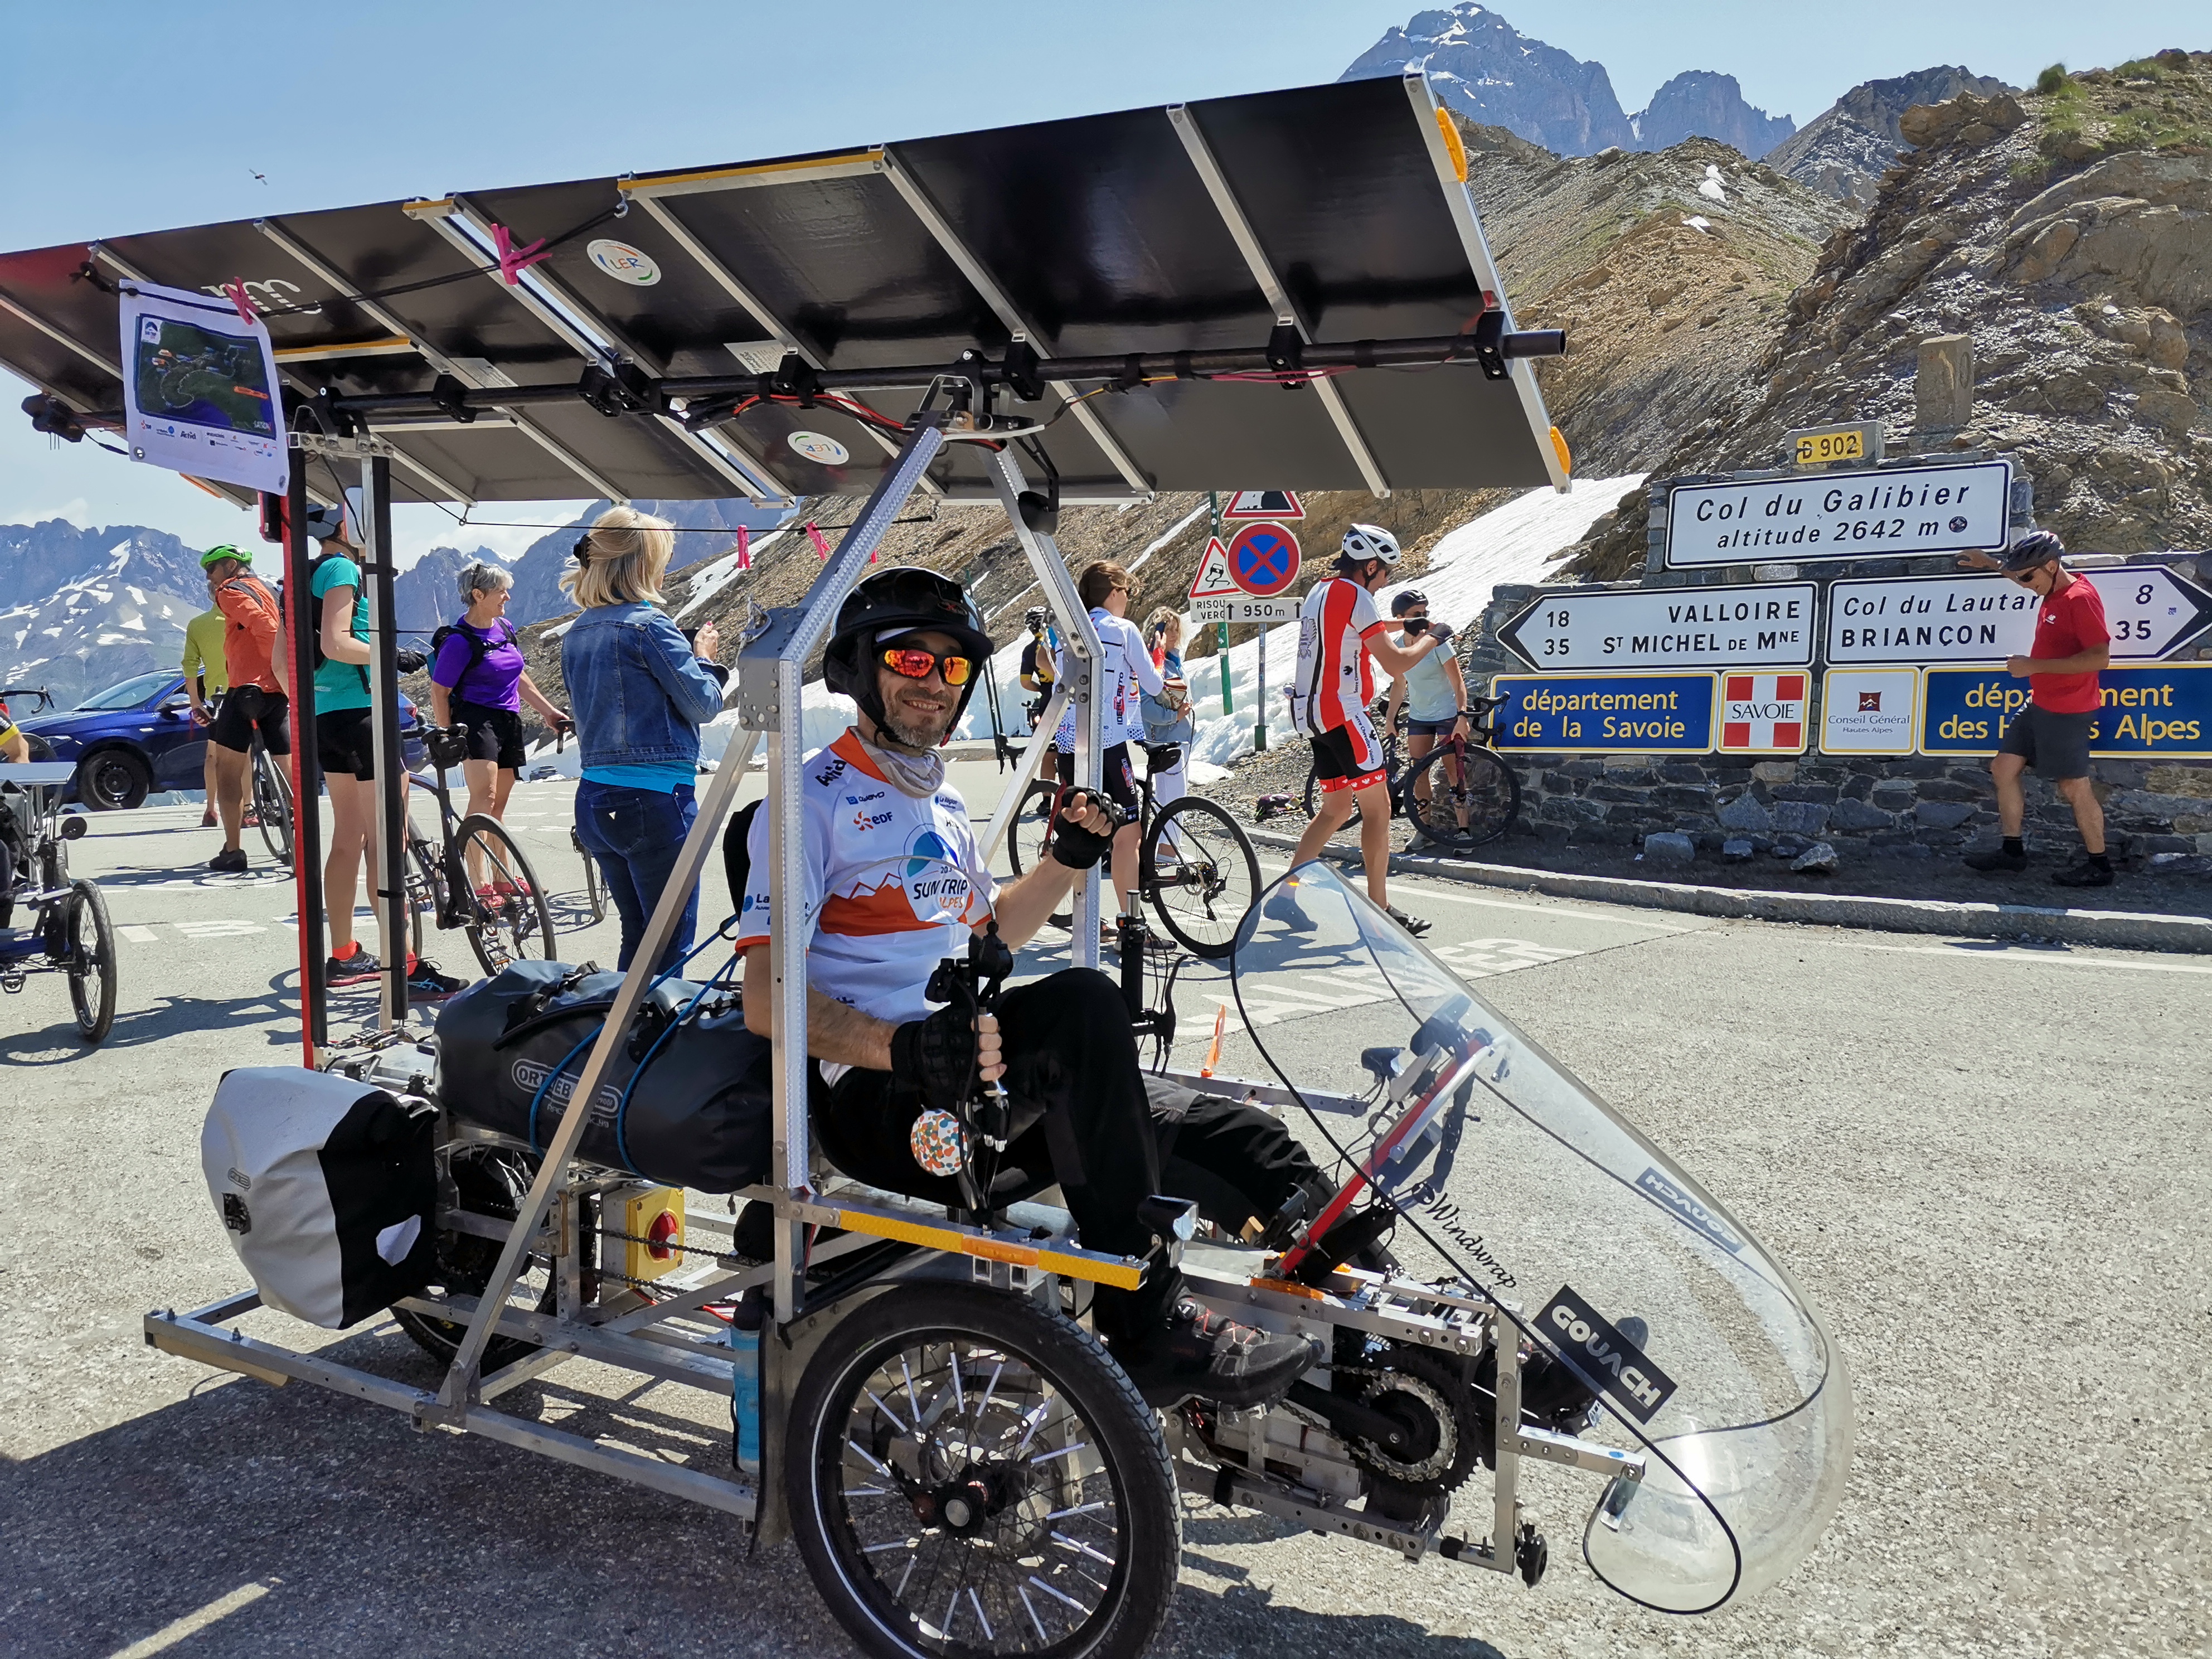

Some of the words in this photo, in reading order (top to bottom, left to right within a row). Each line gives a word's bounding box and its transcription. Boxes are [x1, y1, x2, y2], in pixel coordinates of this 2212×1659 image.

[1801, 440, 1812, 460] D
[1821, 435, 1858, 458] 902
[1697, 497, 1747, 522] Col
[1765, 494, 1802, 517] du
[1823, 483, 1970, 513] Galibier
[1717, 525, 1820, 549] altitude
[1833, 518, 1905, 542] 2642
[1918, 522, 1939, 536] m
[1196, 600, 1225, 609] RISQU
[1244, 605, 1273, 617] 950
[1844, 596, 1886, 615] Col
[1900, 594, 1932, 614] du
[1946, 593, 2040, 613] Lautar
[2136, 584, 2153, 605] 8
[1200, 610, 1225, 619] VERG
[1547, 611, 1570, 628] 18
[1668, 601, 1799, 623] VALLOIRE
[1544, 639, 1570, 656] 35
[1632, 634, 1719, 653] MICHEL
[1728, 639, 1747, 651] DE
[1841, 624, 1996, 648] BRIANÇON
[2115, 620, 2151, 641] 35
[1522, 689, 1679, 715] département
[1965, 682, 2174, 714] dépment
[1732, 703, 1794, 720] SAVOIE
[1828, 715, 1865, 724] Conseil
[1869, 715, 1910, 724] Général
[1514, 717, 1541, 738] de
[1563, 716, 1581, 738] la
[1603, 716, 1685, 739] Savoie
[1939, 714, 1988, 739] des
[2114, 715, 2200, 746] Alpes
[756, 894, 770, 903] La
[914, 880, 941, 900] SUN
[941, 879, 968, 895] TRIP
[1425, 1192, 1516, 1288] Windwrap
[1551, 1305, 1661, 1409] GOUACH
